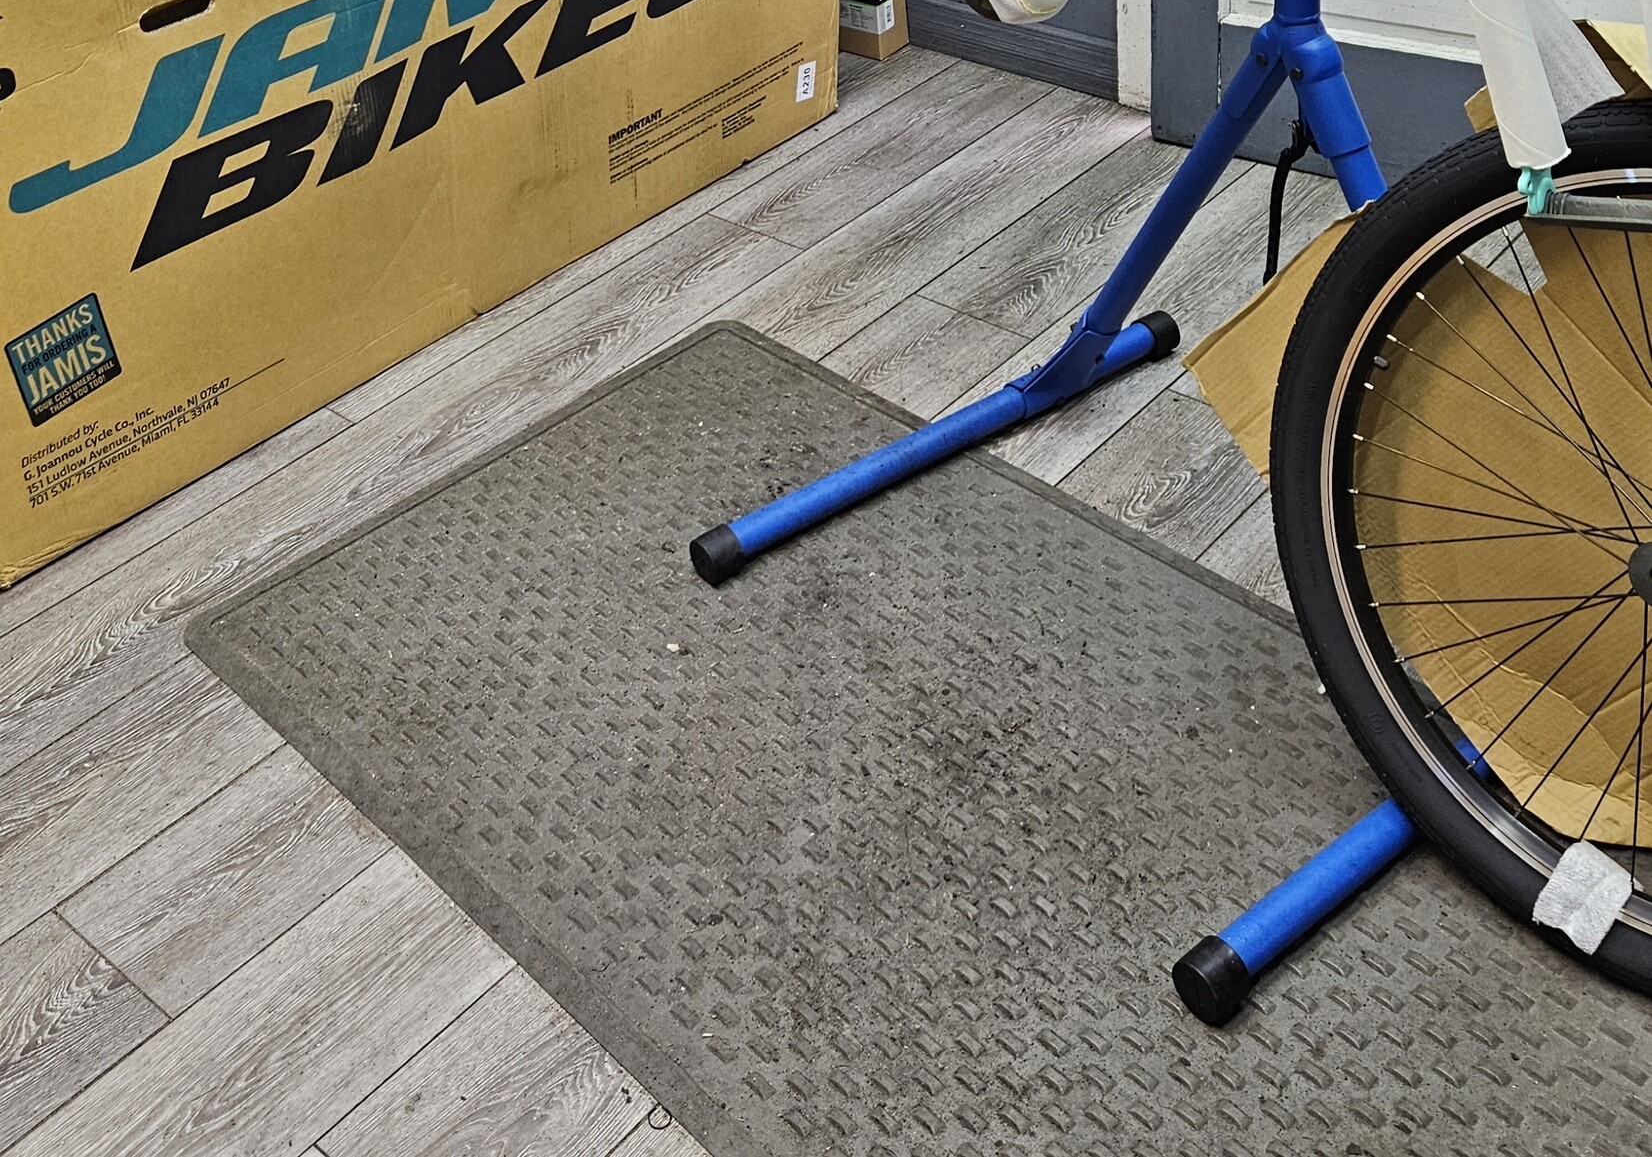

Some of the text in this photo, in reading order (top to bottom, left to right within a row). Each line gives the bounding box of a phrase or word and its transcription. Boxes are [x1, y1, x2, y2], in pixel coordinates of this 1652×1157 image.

[802, 67, 811, 95] A230
[608, 108, 662, 144] IMPORTANT
[12, 303, 93, 364] THANKS
[22, 323, 98, 375] FOR ORDERING A
[26, 334, 107, 405] JAMIS
[33, 360, 115, 415] YOUR CUSTOMERS WILL
[50, 375, 106, 414] THANK YOU TOO!
[21, 420, 100, 469] Distributed by:
[24, 405, 155, 482] G. Joannou Cycle Co., Inc.
[26, 377, 230, 495] 151 Ludlow Avenue, Northvale, NJ 07647
[29, 398, 220, 509] 701 S.W. 71st Avenue, Miami, FL 33144
